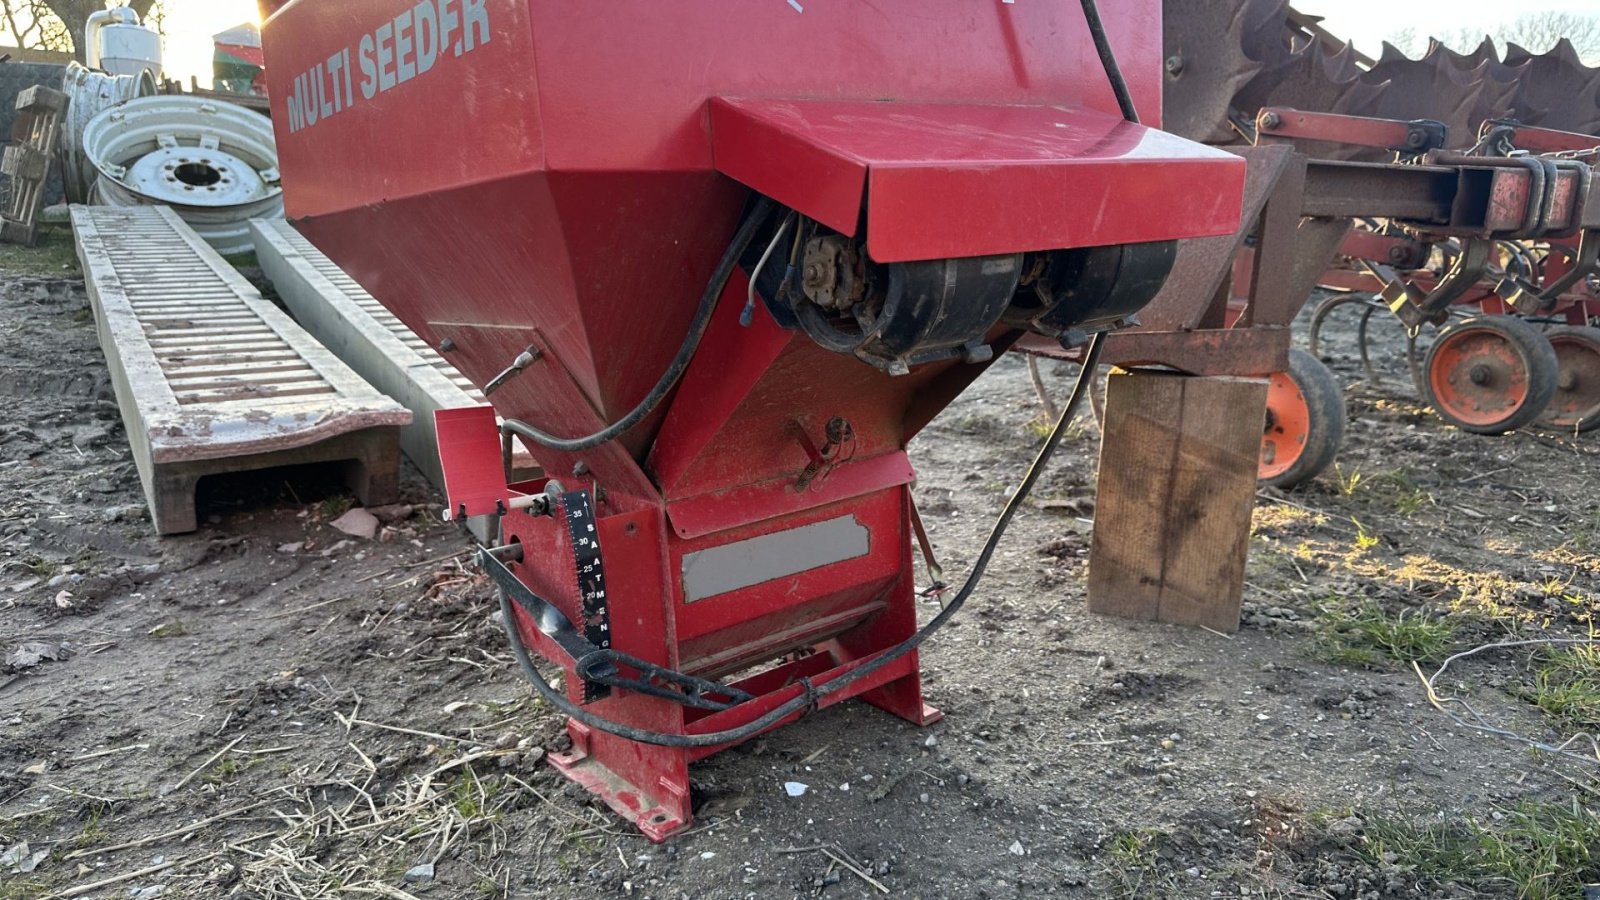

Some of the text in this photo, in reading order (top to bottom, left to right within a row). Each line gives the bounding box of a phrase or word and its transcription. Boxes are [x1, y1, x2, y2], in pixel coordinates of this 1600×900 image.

[287, 0, 491, 133] MULTI SEEDER
[573, 509, 583, 518] 35
[579, 537, 588, 546] 30
[583, 564, 593, 573] 25
